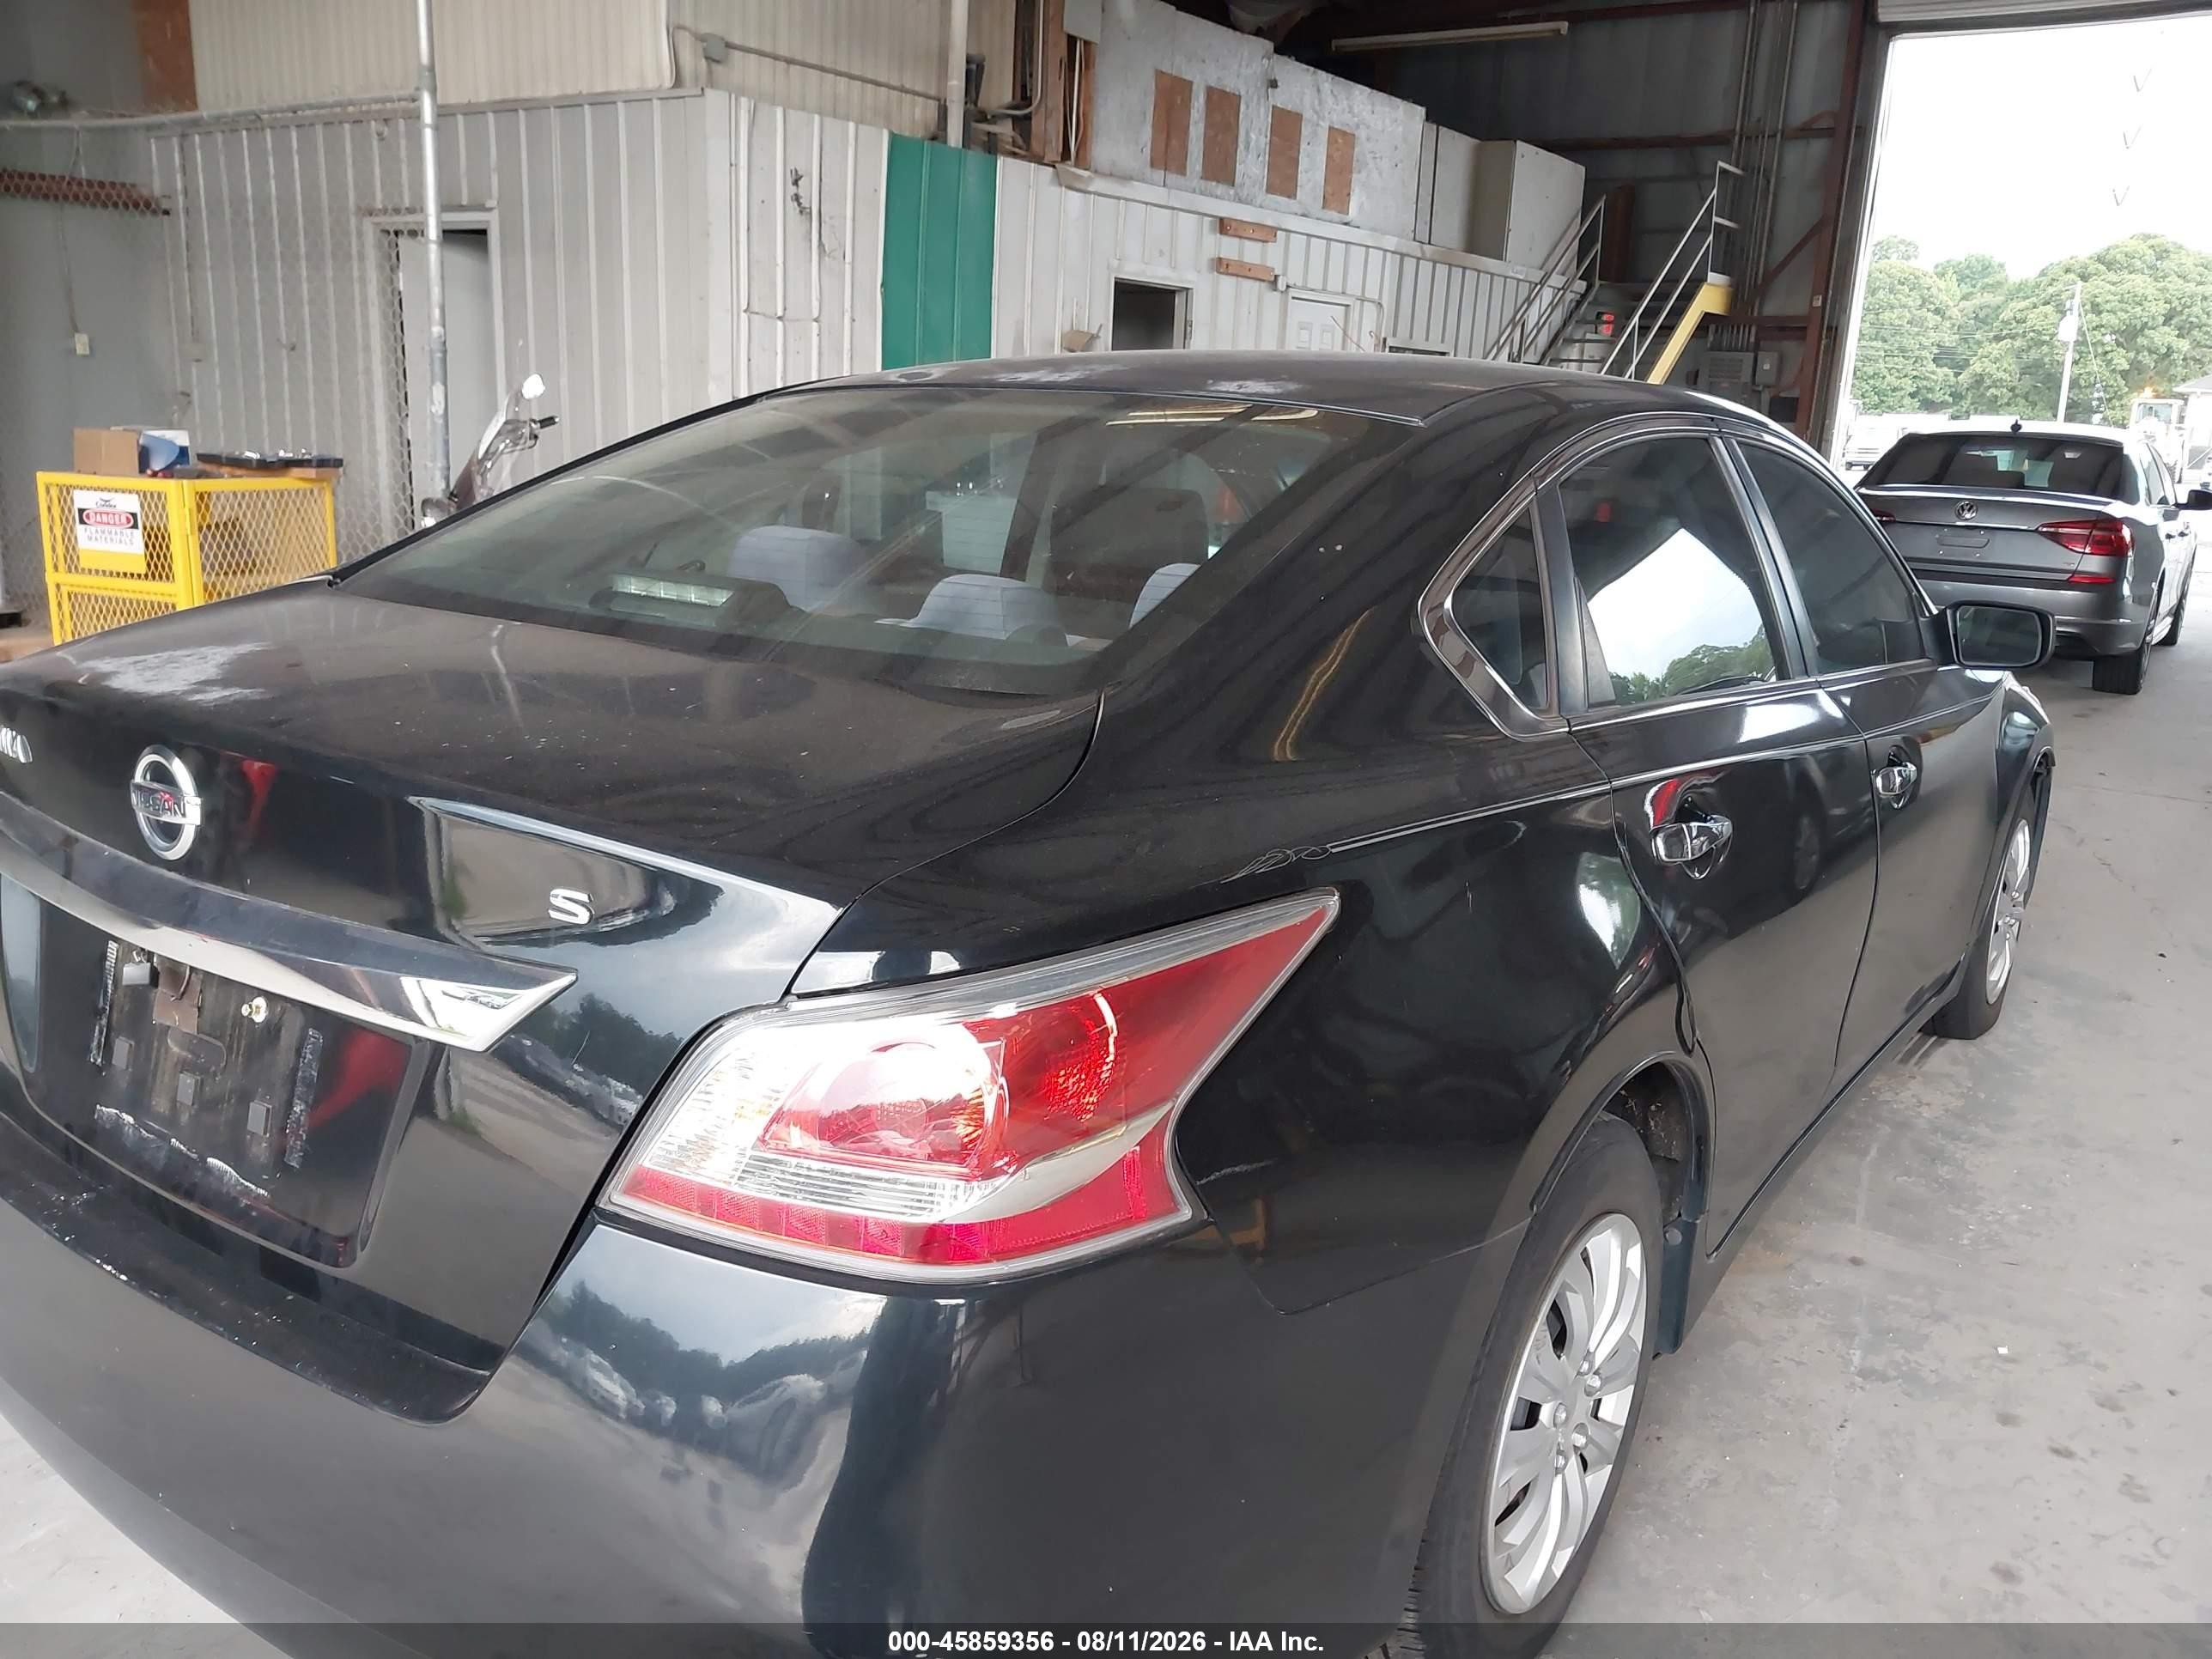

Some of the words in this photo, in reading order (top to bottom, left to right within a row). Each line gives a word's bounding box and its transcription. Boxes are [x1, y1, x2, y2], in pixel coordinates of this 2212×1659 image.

[88, 512, 128, 526] DANGER
[83, 527, 135, 538] FLAMMABLE
[87, 535, 135, 546] MATERIALS
[131, 788, 187, 818] NISSAN
[547, 888, 595, 925] S
